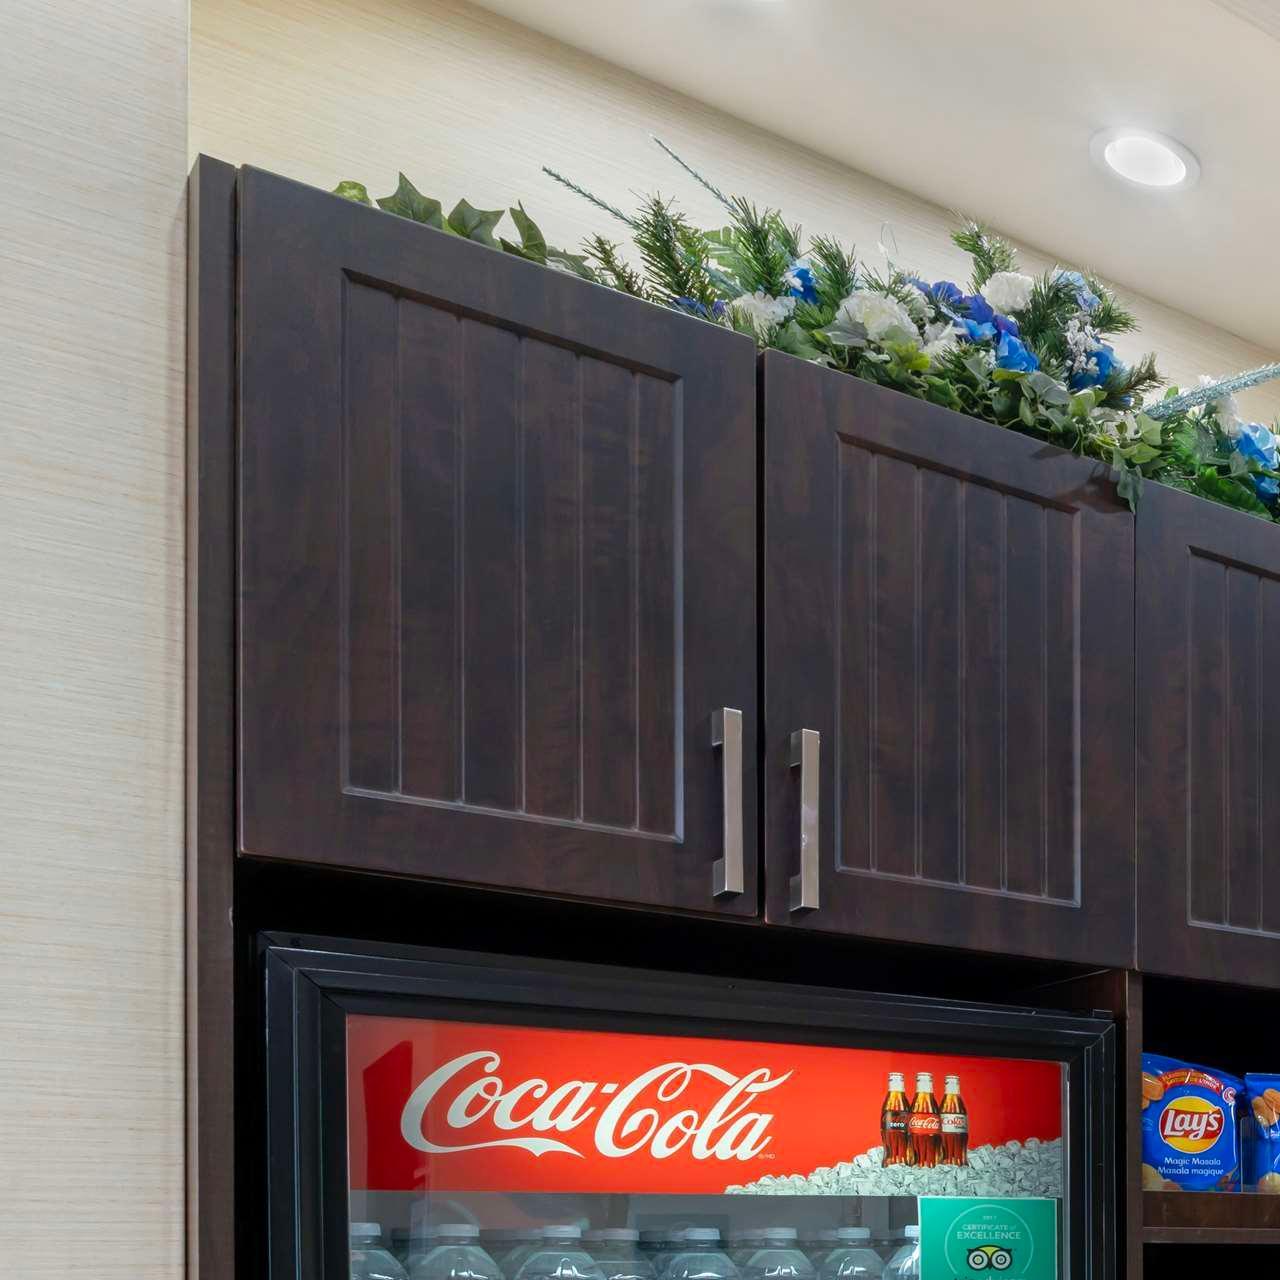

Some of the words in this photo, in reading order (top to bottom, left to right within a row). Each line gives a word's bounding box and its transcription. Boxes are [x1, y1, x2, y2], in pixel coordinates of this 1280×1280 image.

[400, 1050, 794, 1161] Coca-Cola
[1164, 1109, 1221, 1140] Lay's
[1164, 1157, 1190, 1167] Magic
[1191, 1157, 1221, 1166] Masala
[1158, 1166, 1190, 1175] Masala
[1191, 1168, 1224, 1177] magique
[956, 1231, 1022, 1240] EXCELLENCE
